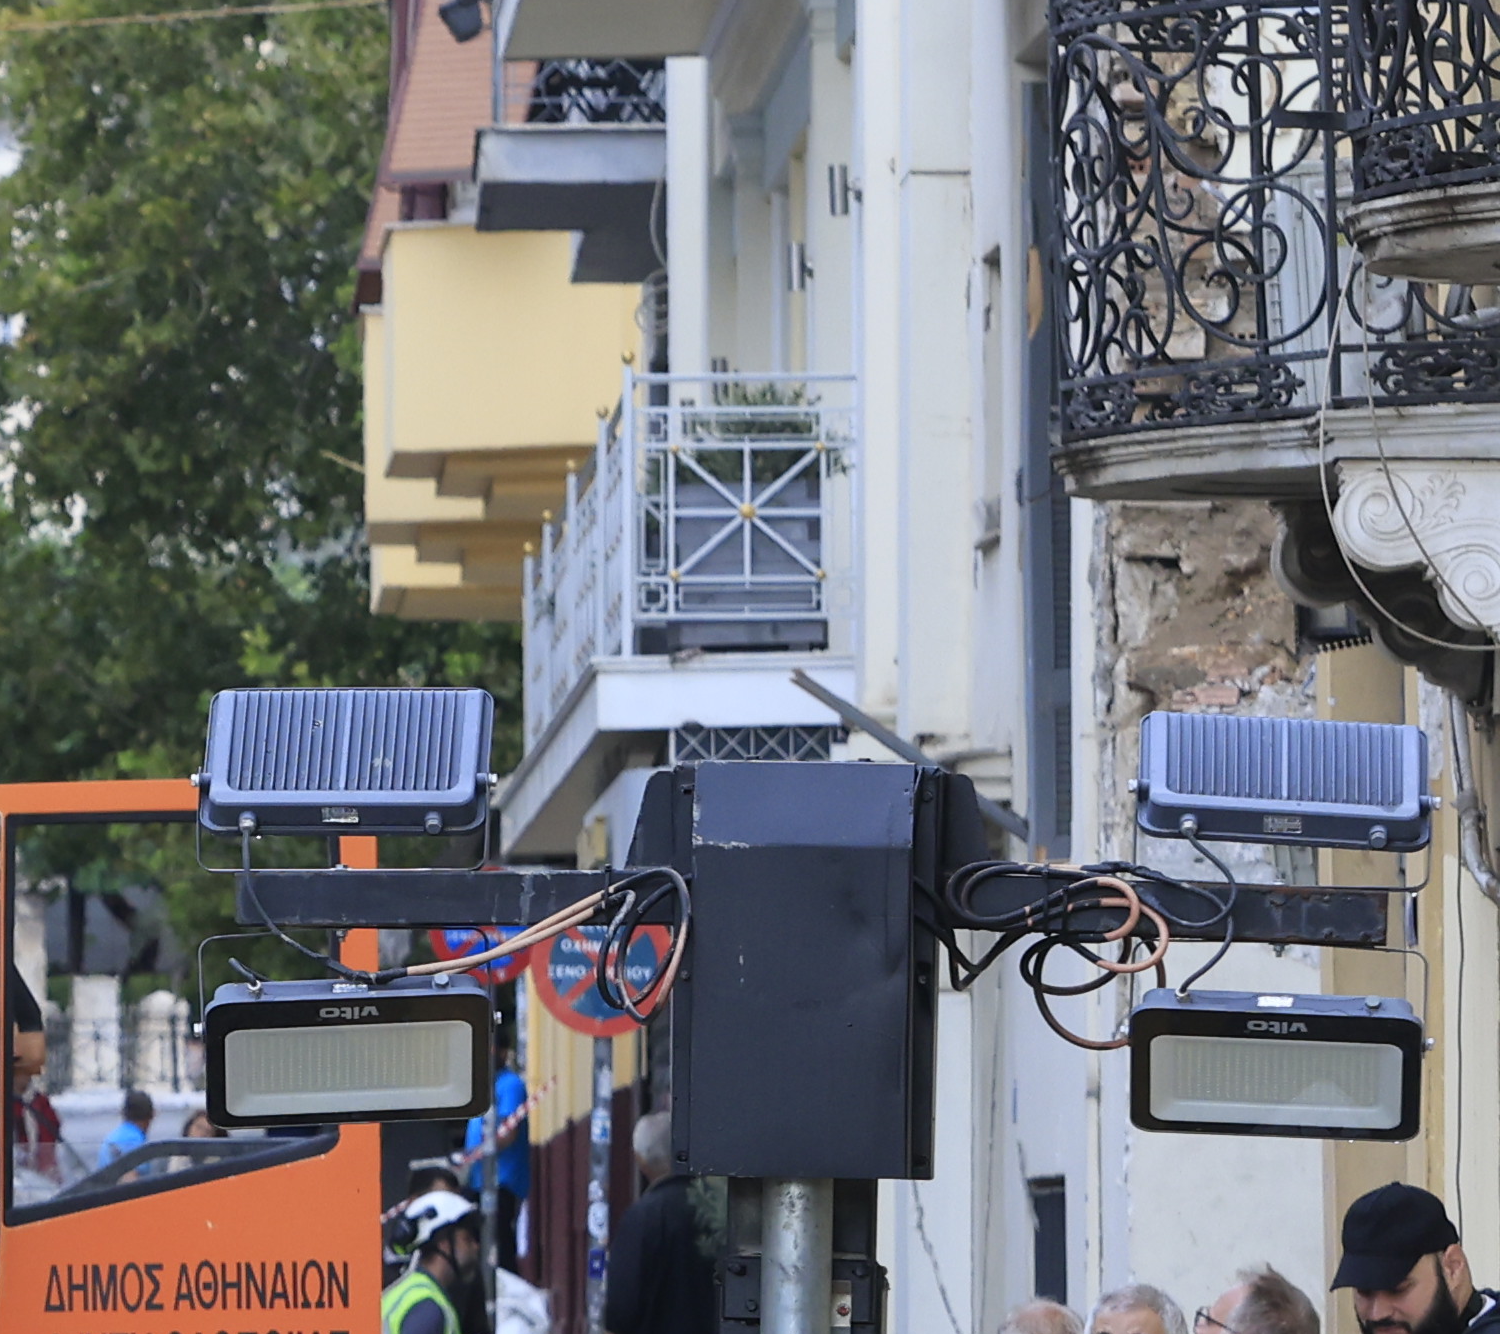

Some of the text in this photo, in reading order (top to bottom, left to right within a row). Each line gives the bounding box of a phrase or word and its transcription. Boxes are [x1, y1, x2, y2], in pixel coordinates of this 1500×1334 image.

[319, 1005, 379, 1020] vito
[1246, 1019, 1308, 1035] vito
[44, 1259, 350, 1313] ΔΗΜΟΣ ΑΘΗΝΑΙΩΝ
